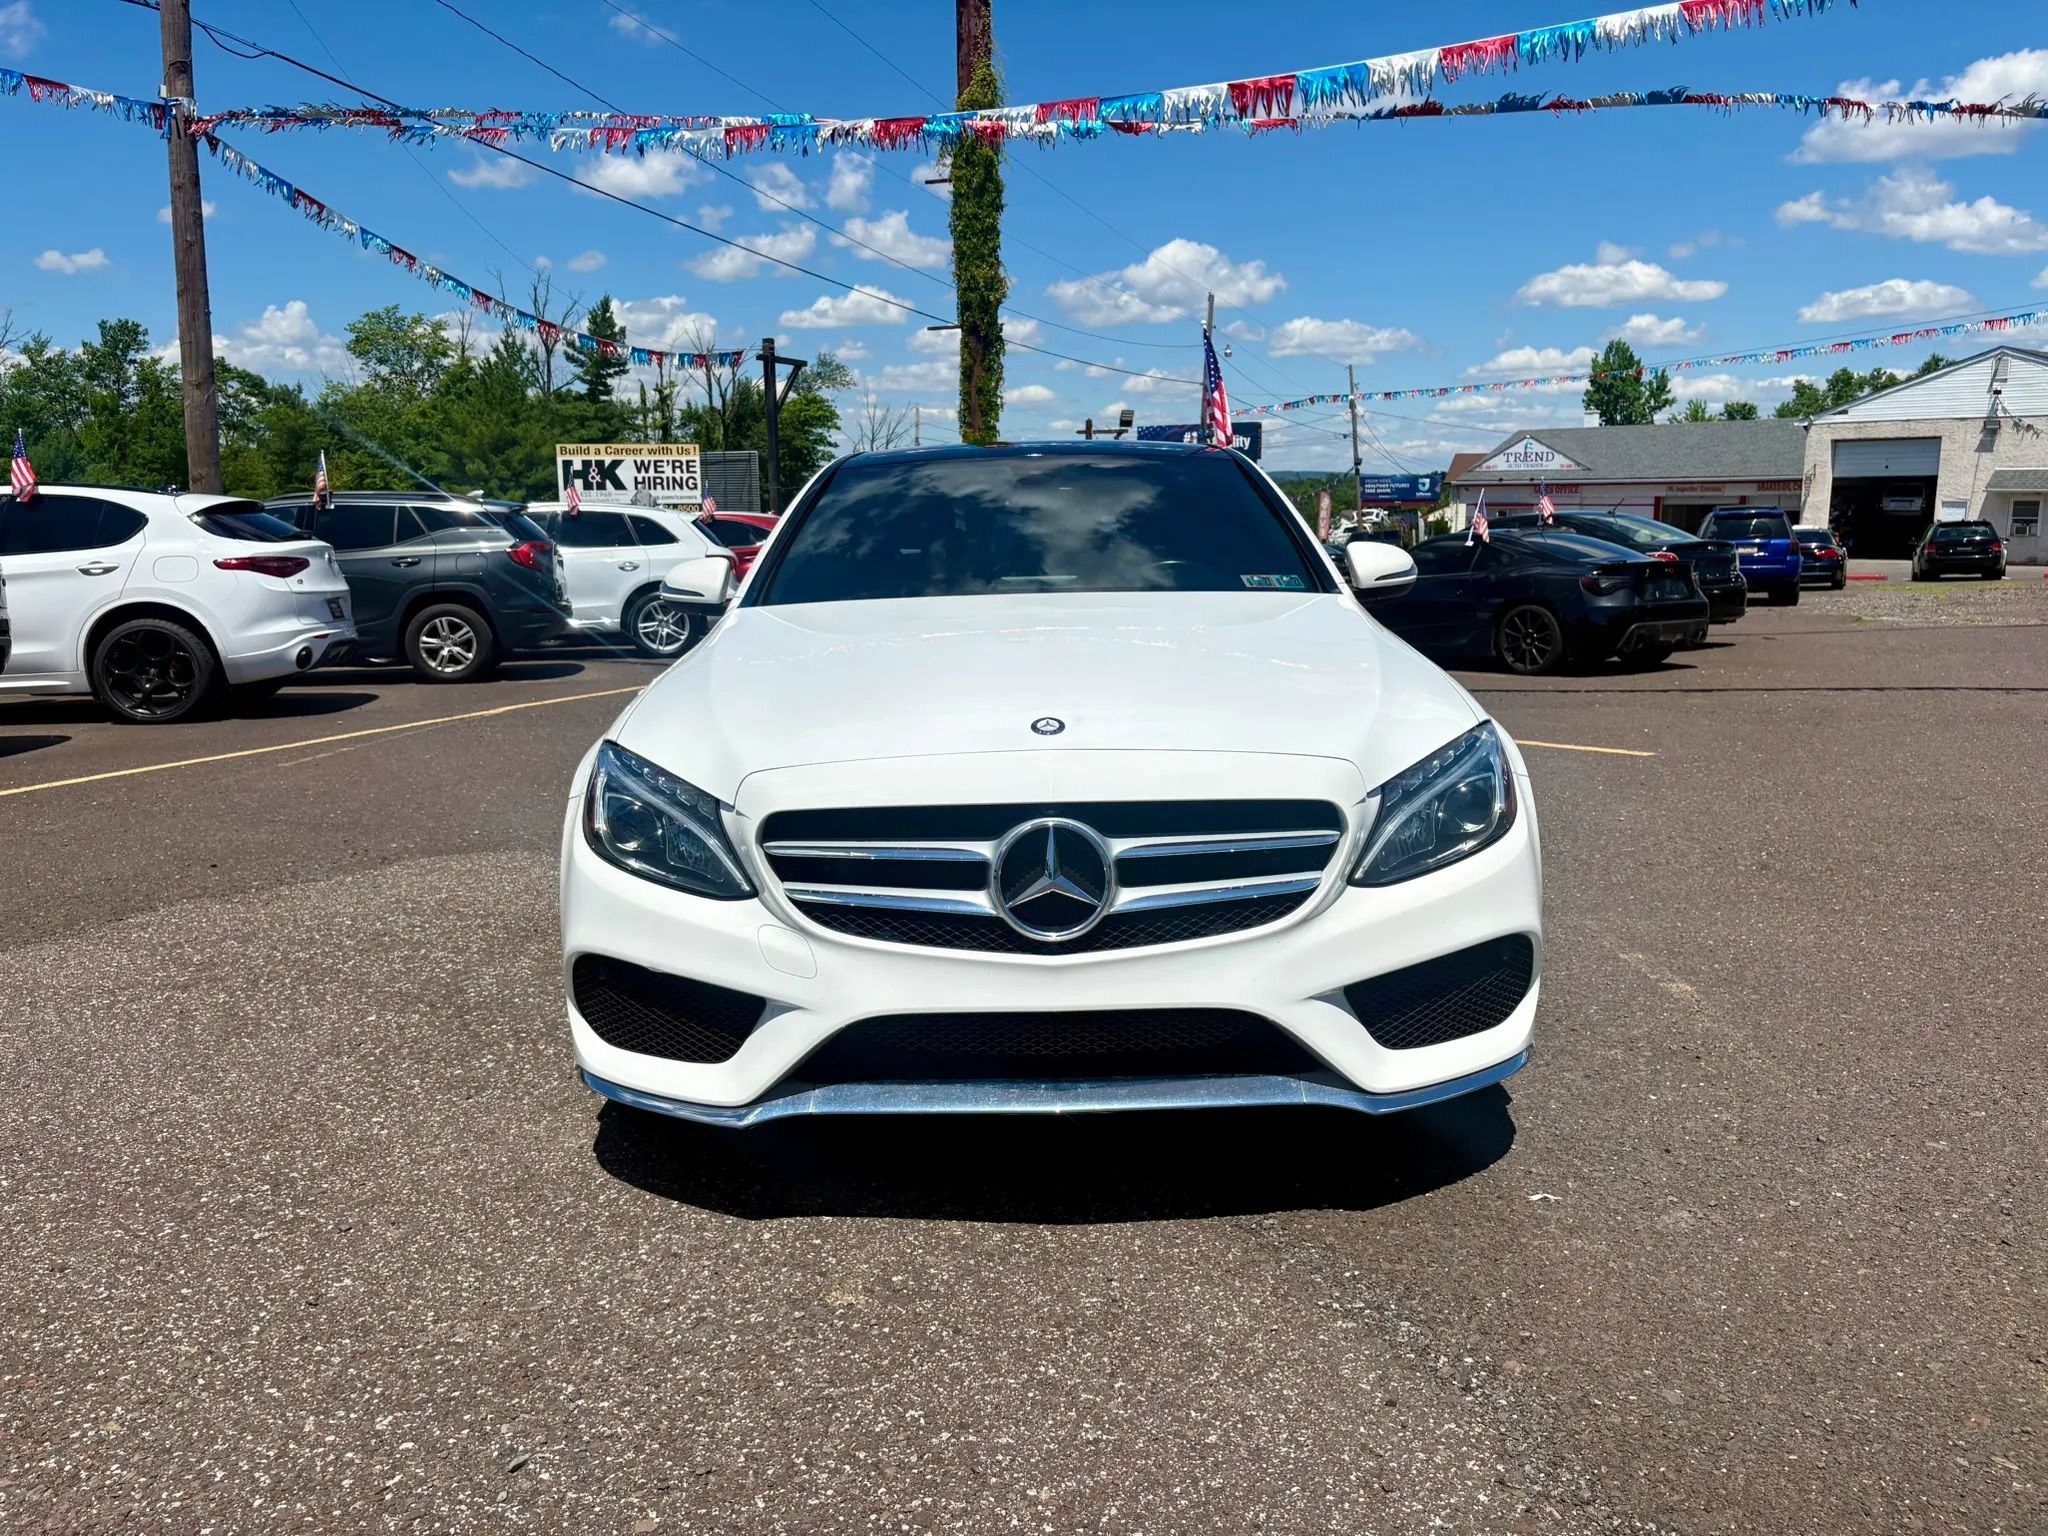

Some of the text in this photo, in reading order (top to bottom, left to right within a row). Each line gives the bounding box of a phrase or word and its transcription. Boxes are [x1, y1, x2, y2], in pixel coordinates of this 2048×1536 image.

[560, 446, 590, 456] Build
[594, 448, 600, 456] a
[604, 446, 643, 456] Career
[647, 446, 673, 456] with
[1503, 451, 1555, 463] TREND
[633, 459, 697, 474] WE'RE
[562, 459, 628, 491] H&K
[634, 476, 698, 490] HIRING
